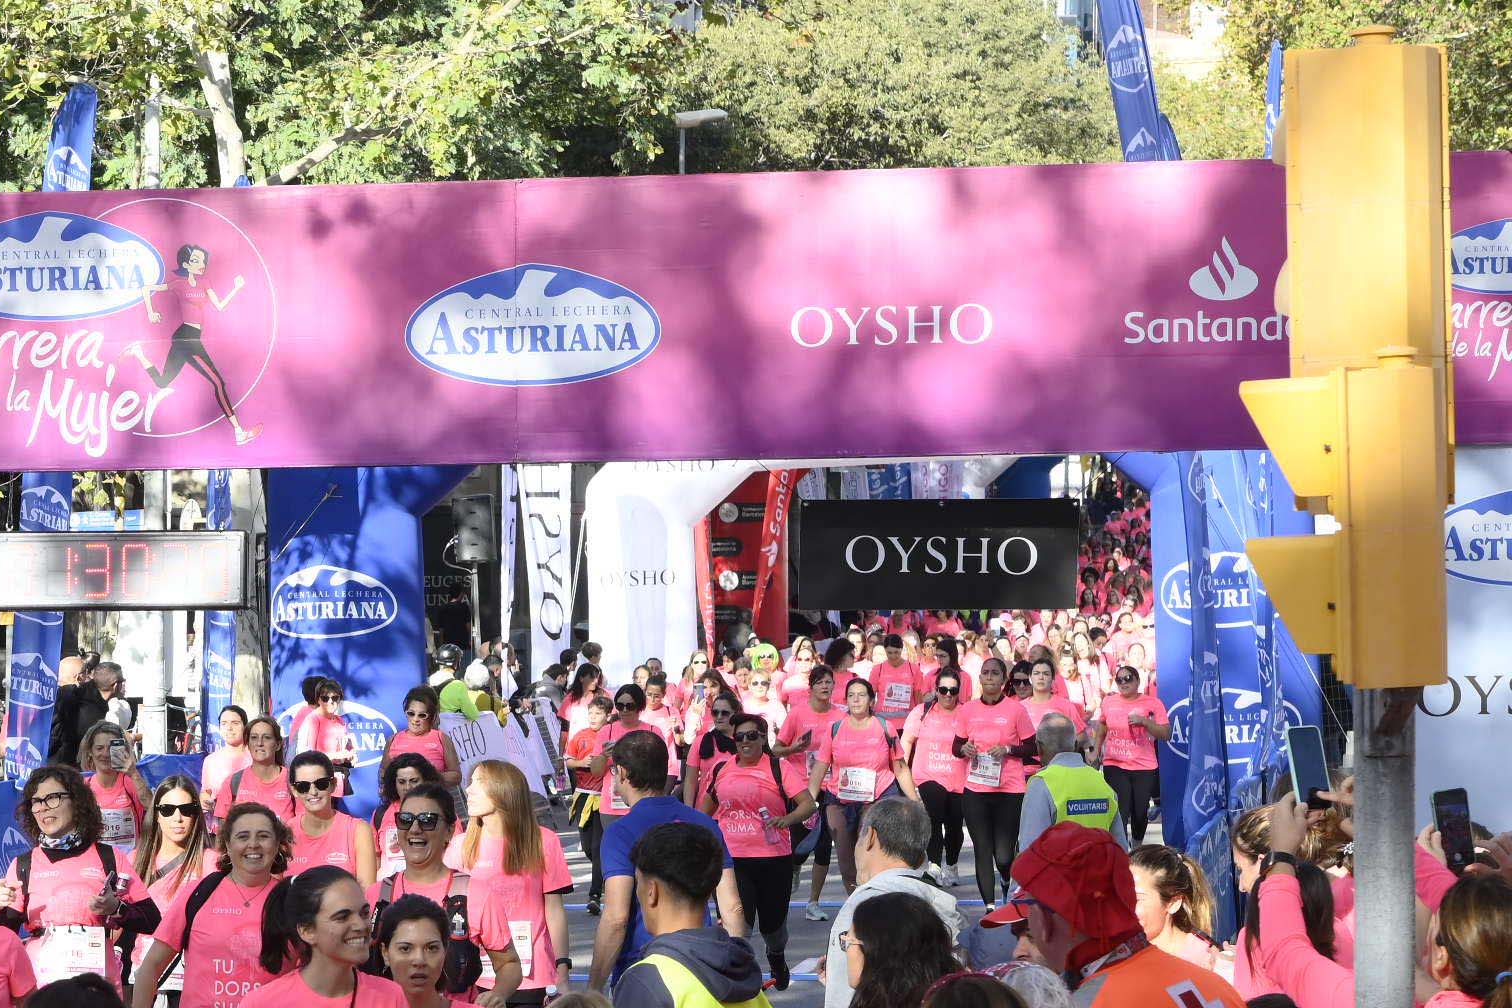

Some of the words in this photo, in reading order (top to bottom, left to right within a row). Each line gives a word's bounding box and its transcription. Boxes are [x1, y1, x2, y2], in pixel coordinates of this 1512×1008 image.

[464, 305, 544, 318] CENTRAL
[551, 304, 632, 317] LECHERA
[425, 311, 641, 356] ASTURIANA
[790, 303, 993, 348] OYSHO
[5, 375, 33, 413] la
[27, 364, 174, 458] Mujer
[769, 470, 788, 537] Santa
[846, 535, 1038, 576] OYSHO
[600, 568, 676, 587] OYSHO
[288, 590, 329, 599] CENTRAL
[334, 590, 383, 598] LECHERA
[274, 595, 388, 622] ASTURIANA
[1068, 801, 1108, 813] VOLUNTARIS
[727, 822, 756, 833] SUMA
[213, 959, 234, 974] TU
